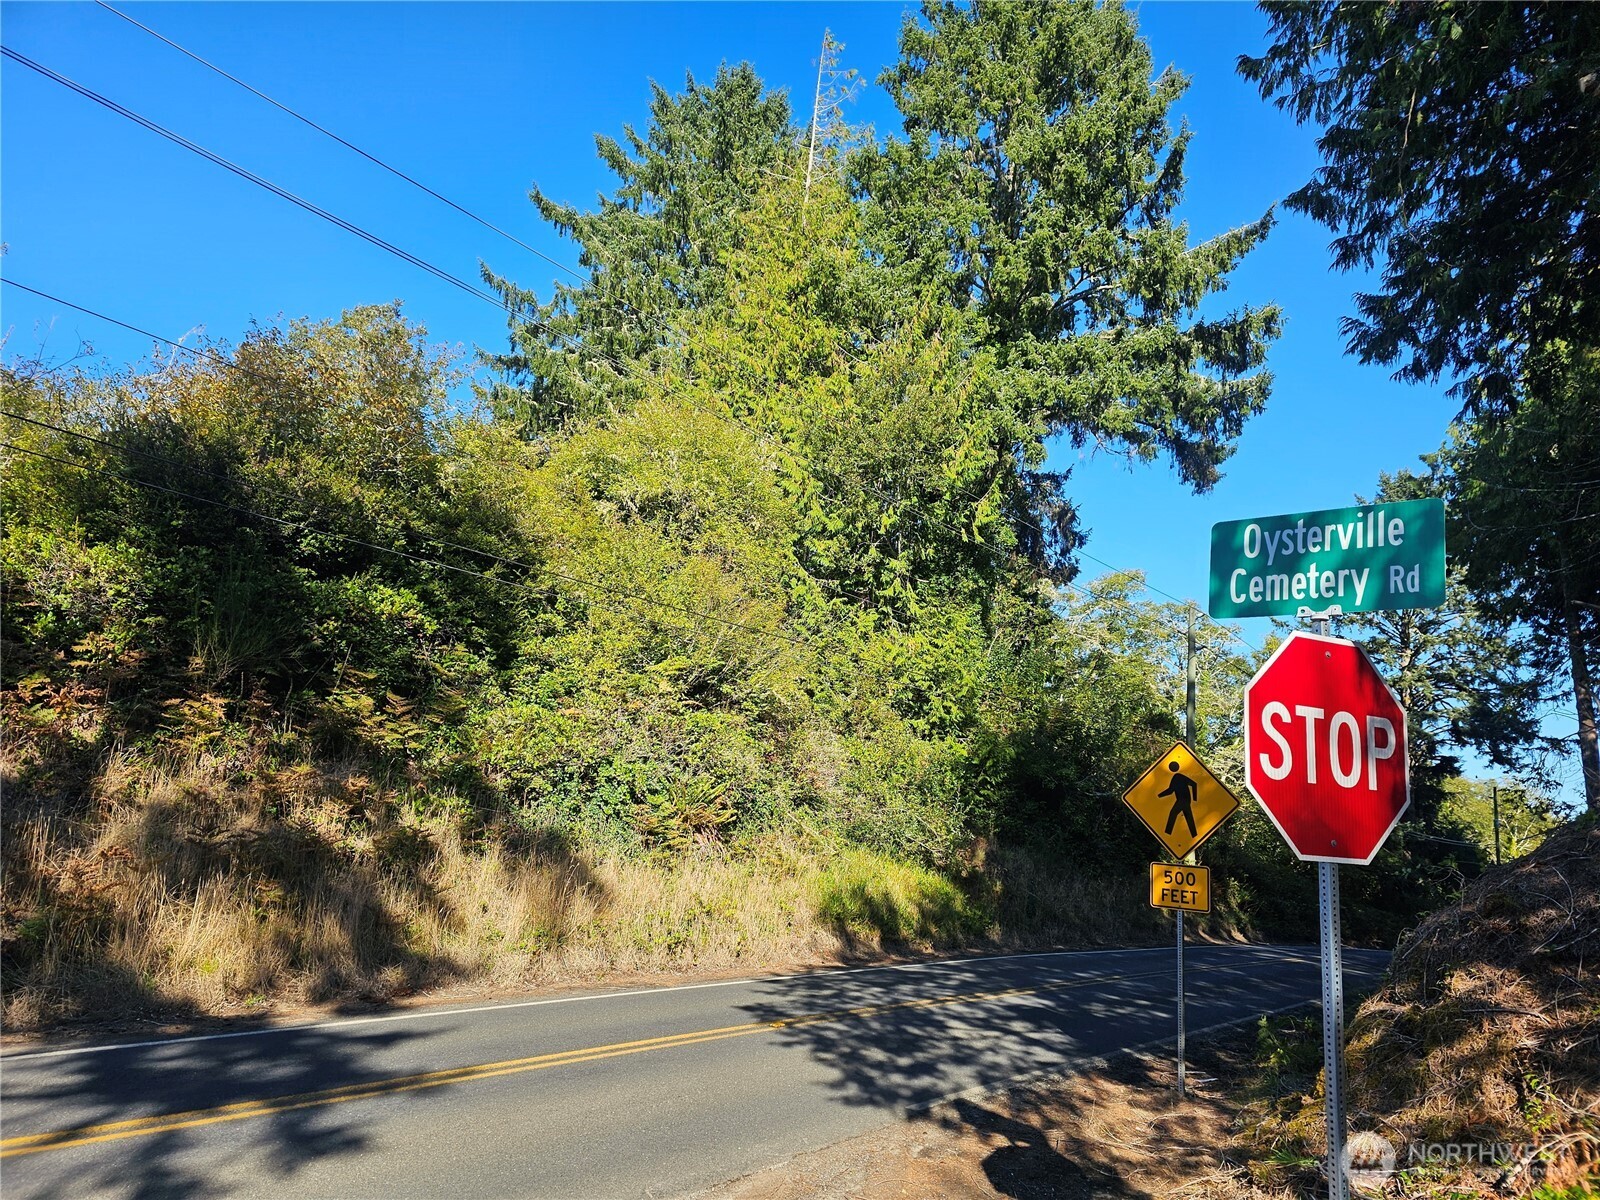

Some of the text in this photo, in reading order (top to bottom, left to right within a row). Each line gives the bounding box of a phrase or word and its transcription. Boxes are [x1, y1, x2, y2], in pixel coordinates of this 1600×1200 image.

[1243, 509, 1404, 566] Oysterville
[1229, 562, 1420, 606] Cemetery Rd
[1259, 701, 1396, 791] STOP
[1161, 888, 1198, 905] FEET
[1164, 870, 1196, 886] 500
